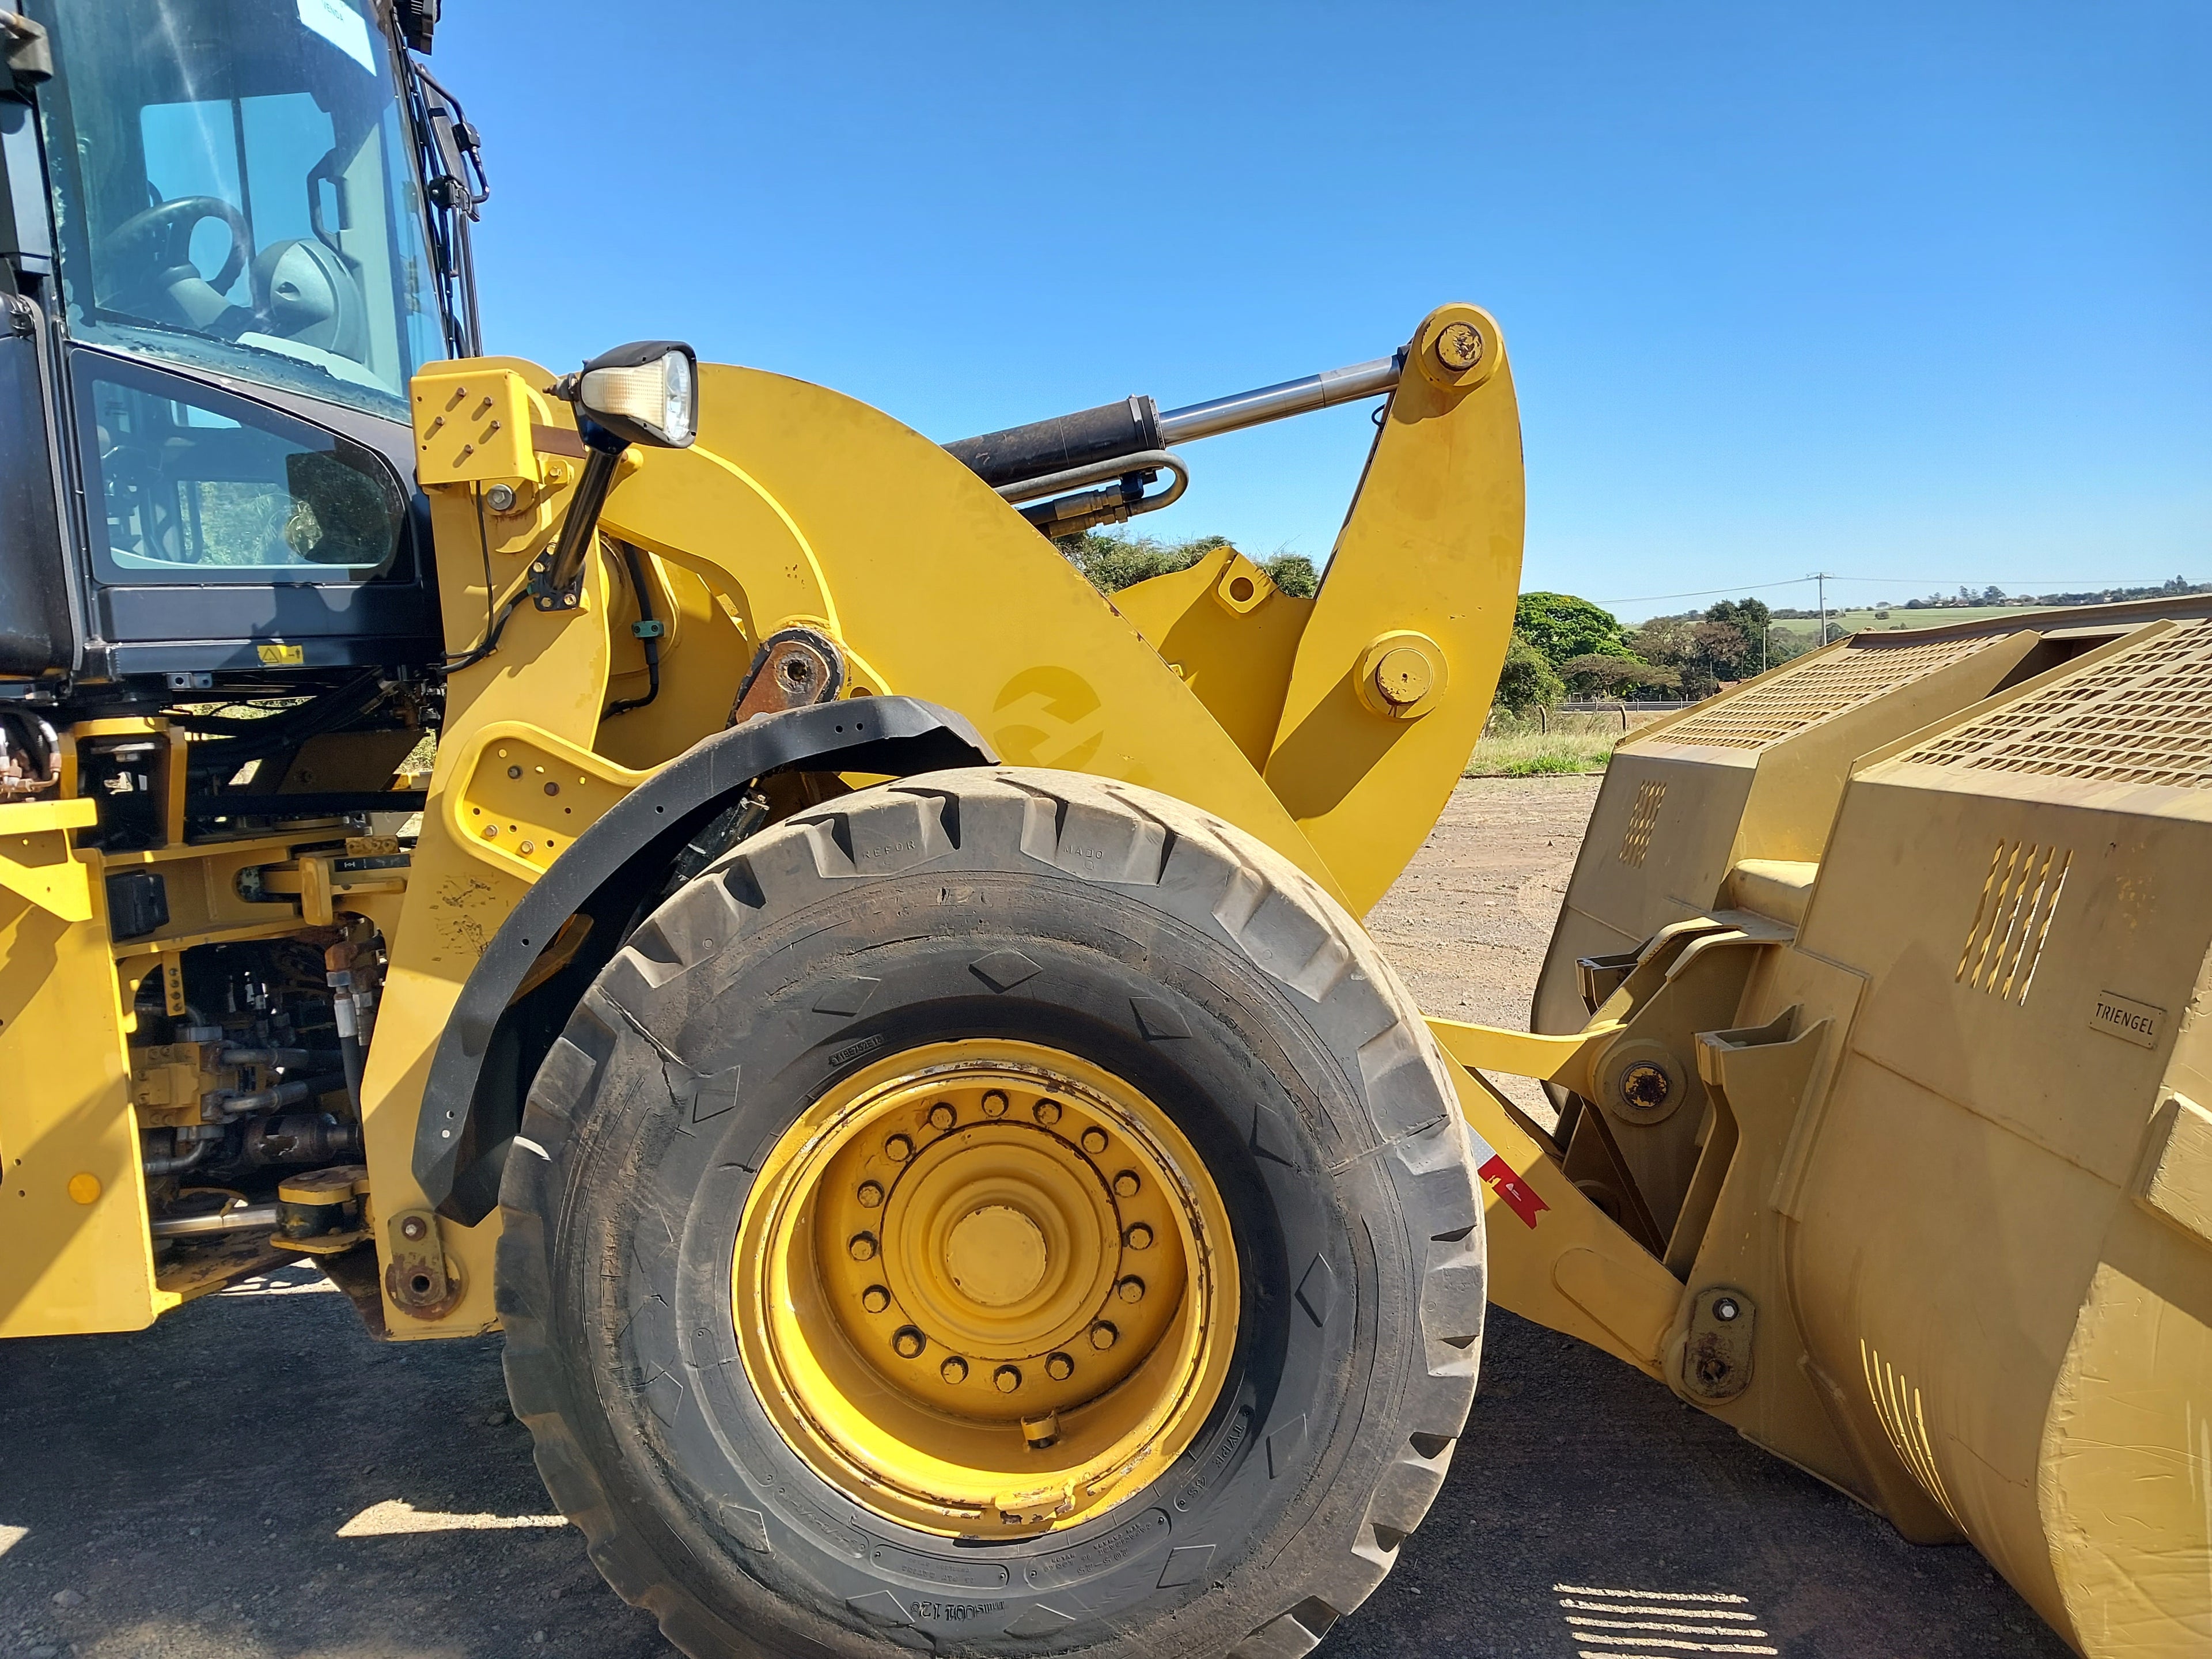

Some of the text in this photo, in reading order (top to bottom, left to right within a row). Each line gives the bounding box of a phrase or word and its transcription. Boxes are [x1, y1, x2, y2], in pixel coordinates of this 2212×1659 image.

[322, 1, 344, 22] VENDA
[2096, 1002, 2153, 1036] TRIENGEL
[1212, 1423, 1246, 1468] TYPE
